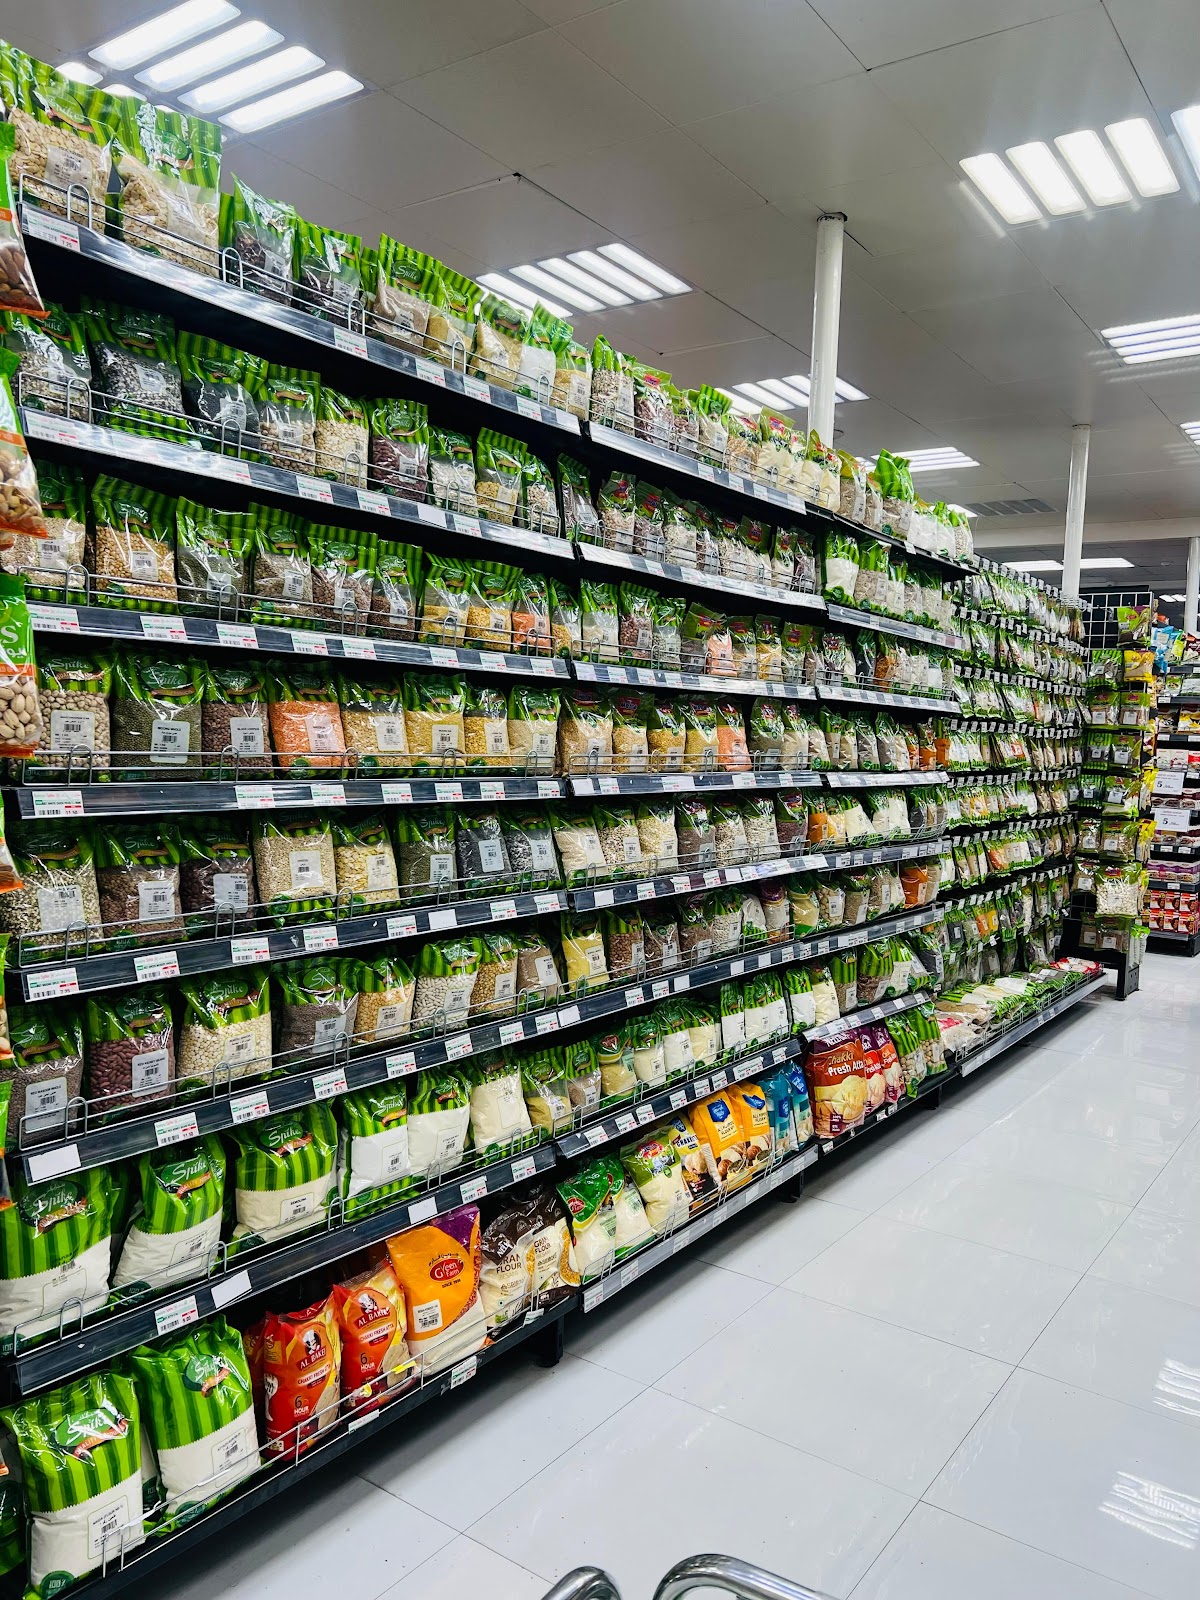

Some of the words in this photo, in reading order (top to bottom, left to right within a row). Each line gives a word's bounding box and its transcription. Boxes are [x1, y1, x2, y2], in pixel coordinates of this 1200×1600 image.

[51, 658, 89, 670] Spike
[421, 818, 444, 829] Spike
[827, 1050, 853, 1066] Chakki
[827, 1061, 851, 1076] Fresh
[268, 1127, 302, 1148] Spike
[169, 1158, 207, 1185] Spike
[434, 1262, 458, 1279] Green
[446, 1269, 460, 1278] Farm
[496, 1262, 522, 1274] FLOUR
[358, 1318, 368, 1328] AL
[300, 1357, 310, 1369] AL
[360, 1352, 367, 1365] 6
[360, 1362, 375, 1370] HOUR
[313, 1368, 325, 1379] FRESH
[294, 1395, 303, 1408] 6
[294, 1405, 309, 1415] HOUR
